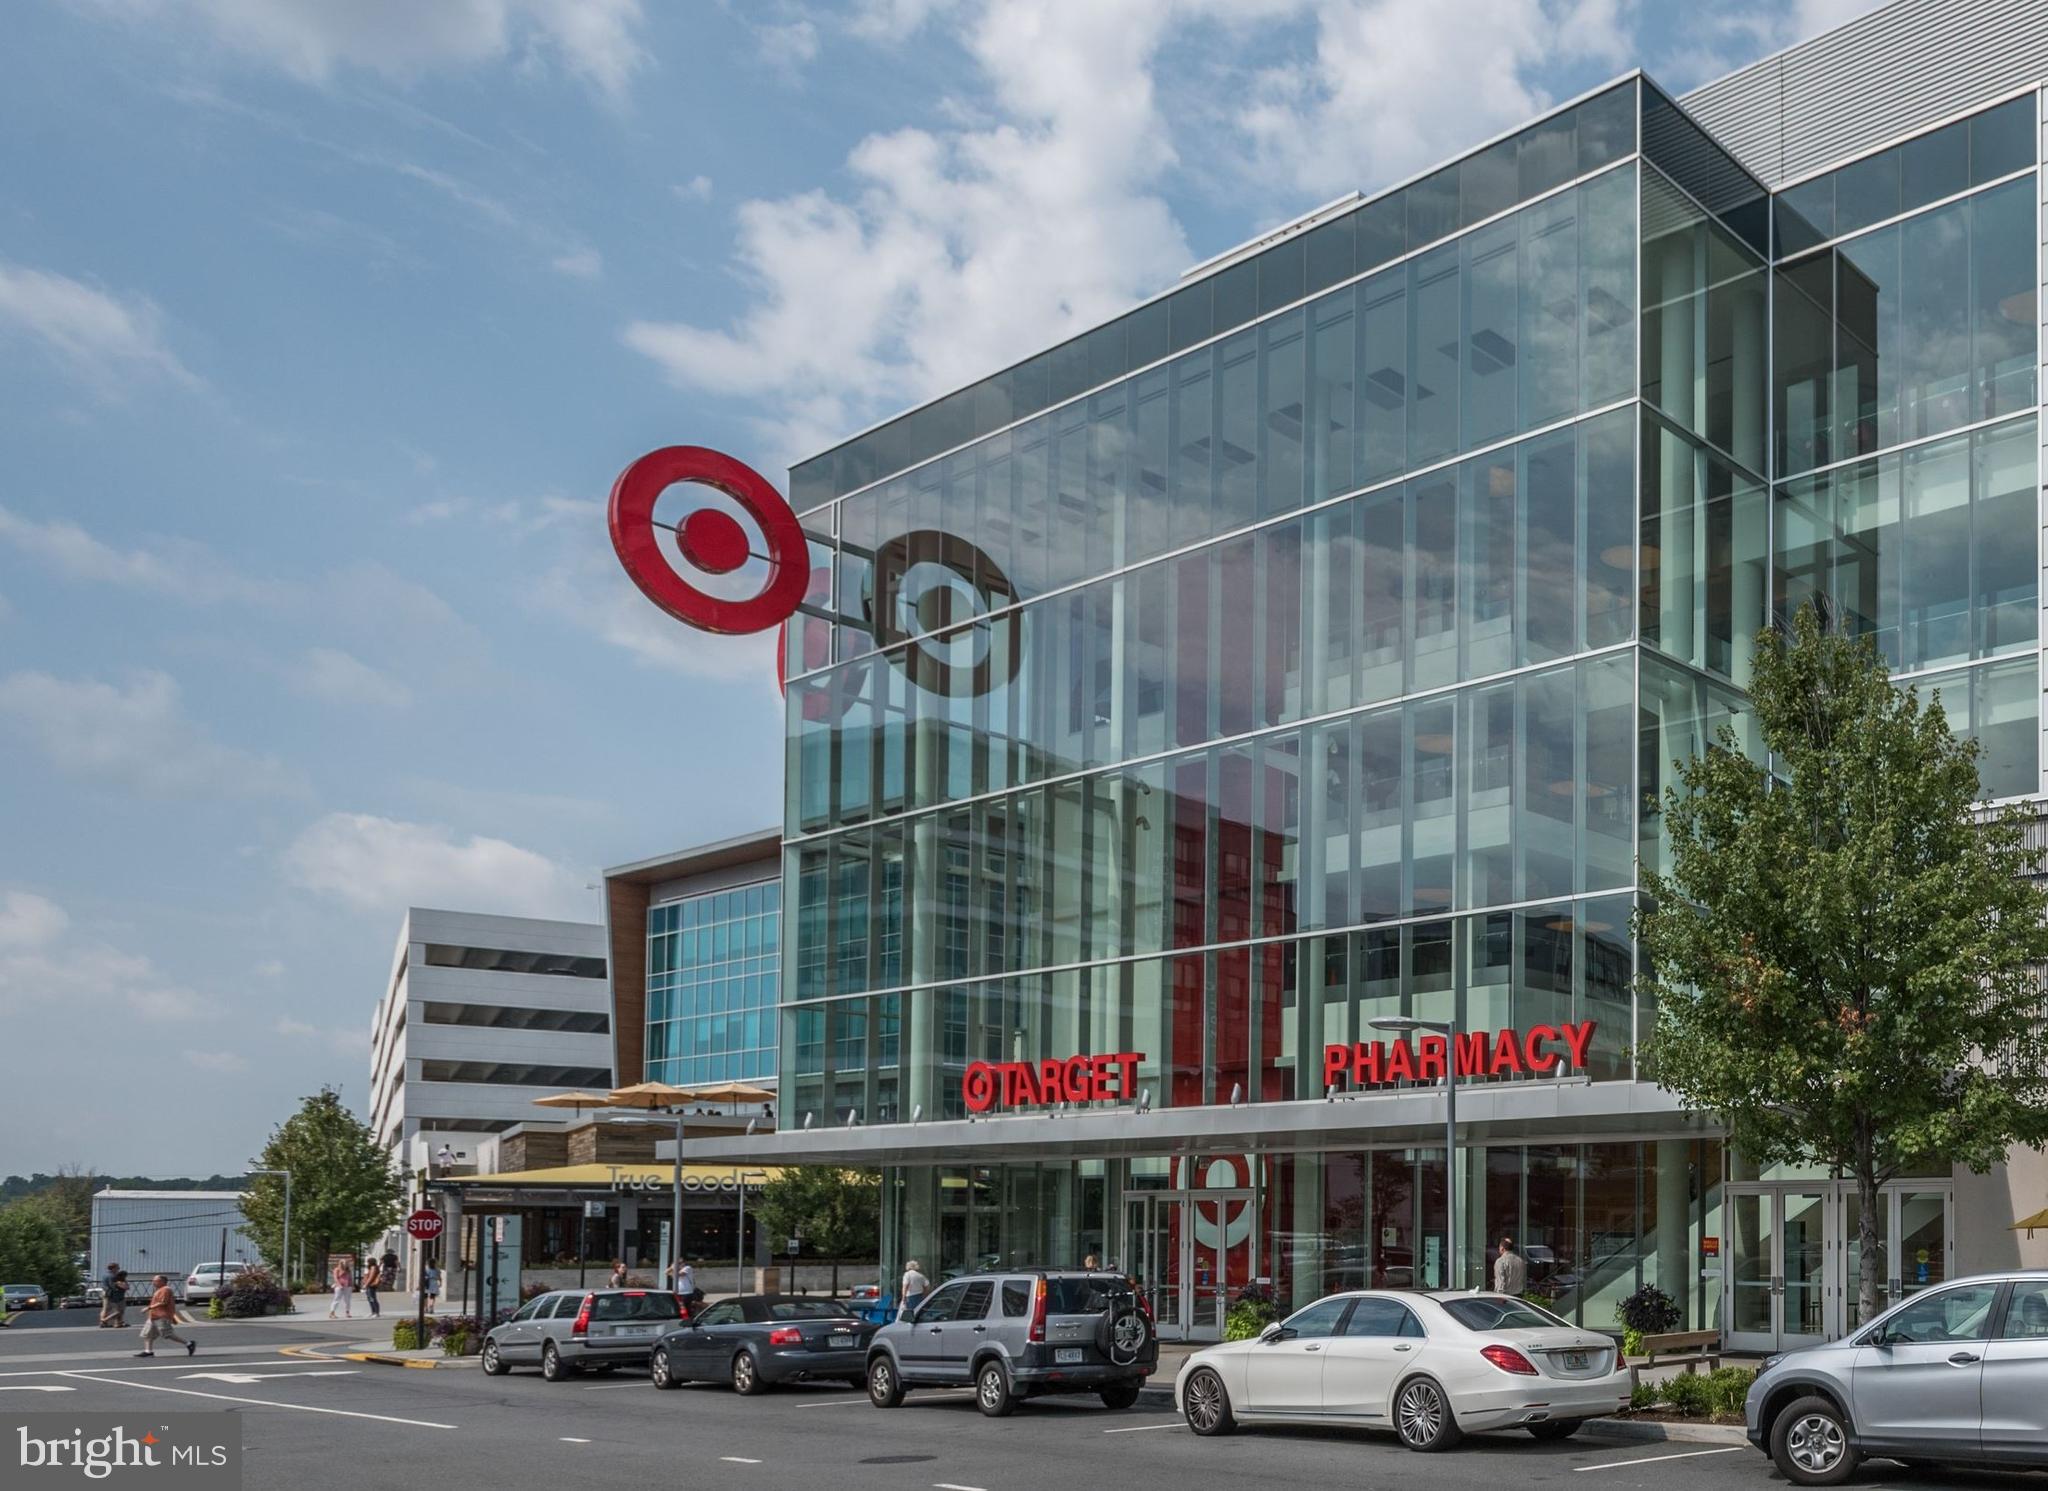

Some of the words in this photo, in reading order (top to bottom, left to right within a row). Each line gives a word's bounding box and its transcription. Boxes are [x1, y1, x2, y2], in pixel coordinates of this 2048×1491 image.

[1324, 1020, 1597, 1086] PHARMACY
[991, 1052, 1146, 1107] TARGET
[606, 1165, 662, 1192] True
[673, 1167, 738, 1192] ood
[408, 1219, 442, 1231] STOP
